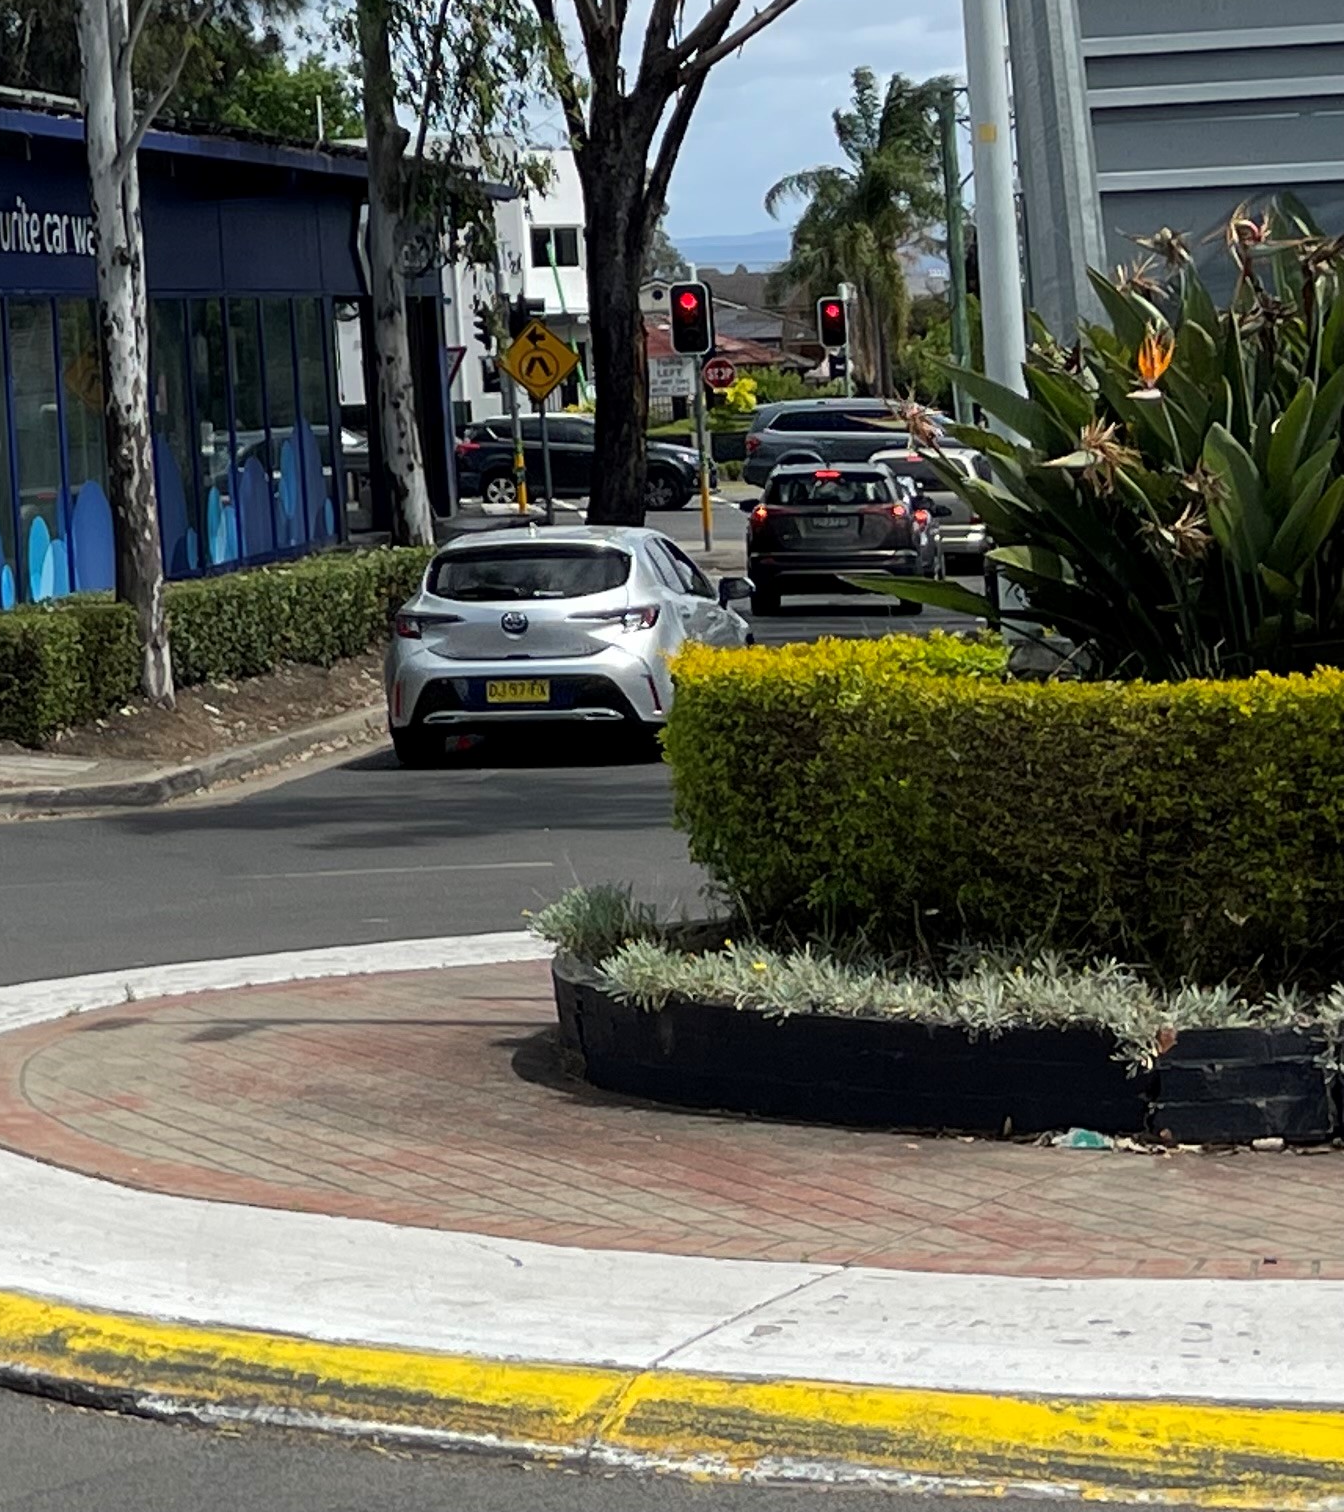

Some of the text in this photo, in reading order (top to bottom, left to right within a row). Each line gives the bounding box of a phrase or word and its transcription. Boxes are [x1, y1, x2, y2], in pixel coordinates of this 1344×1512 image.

[43, 213, 69, 254] car
[70, 216, 96, 257] wa
[706, 367, 733, 380] STOP
